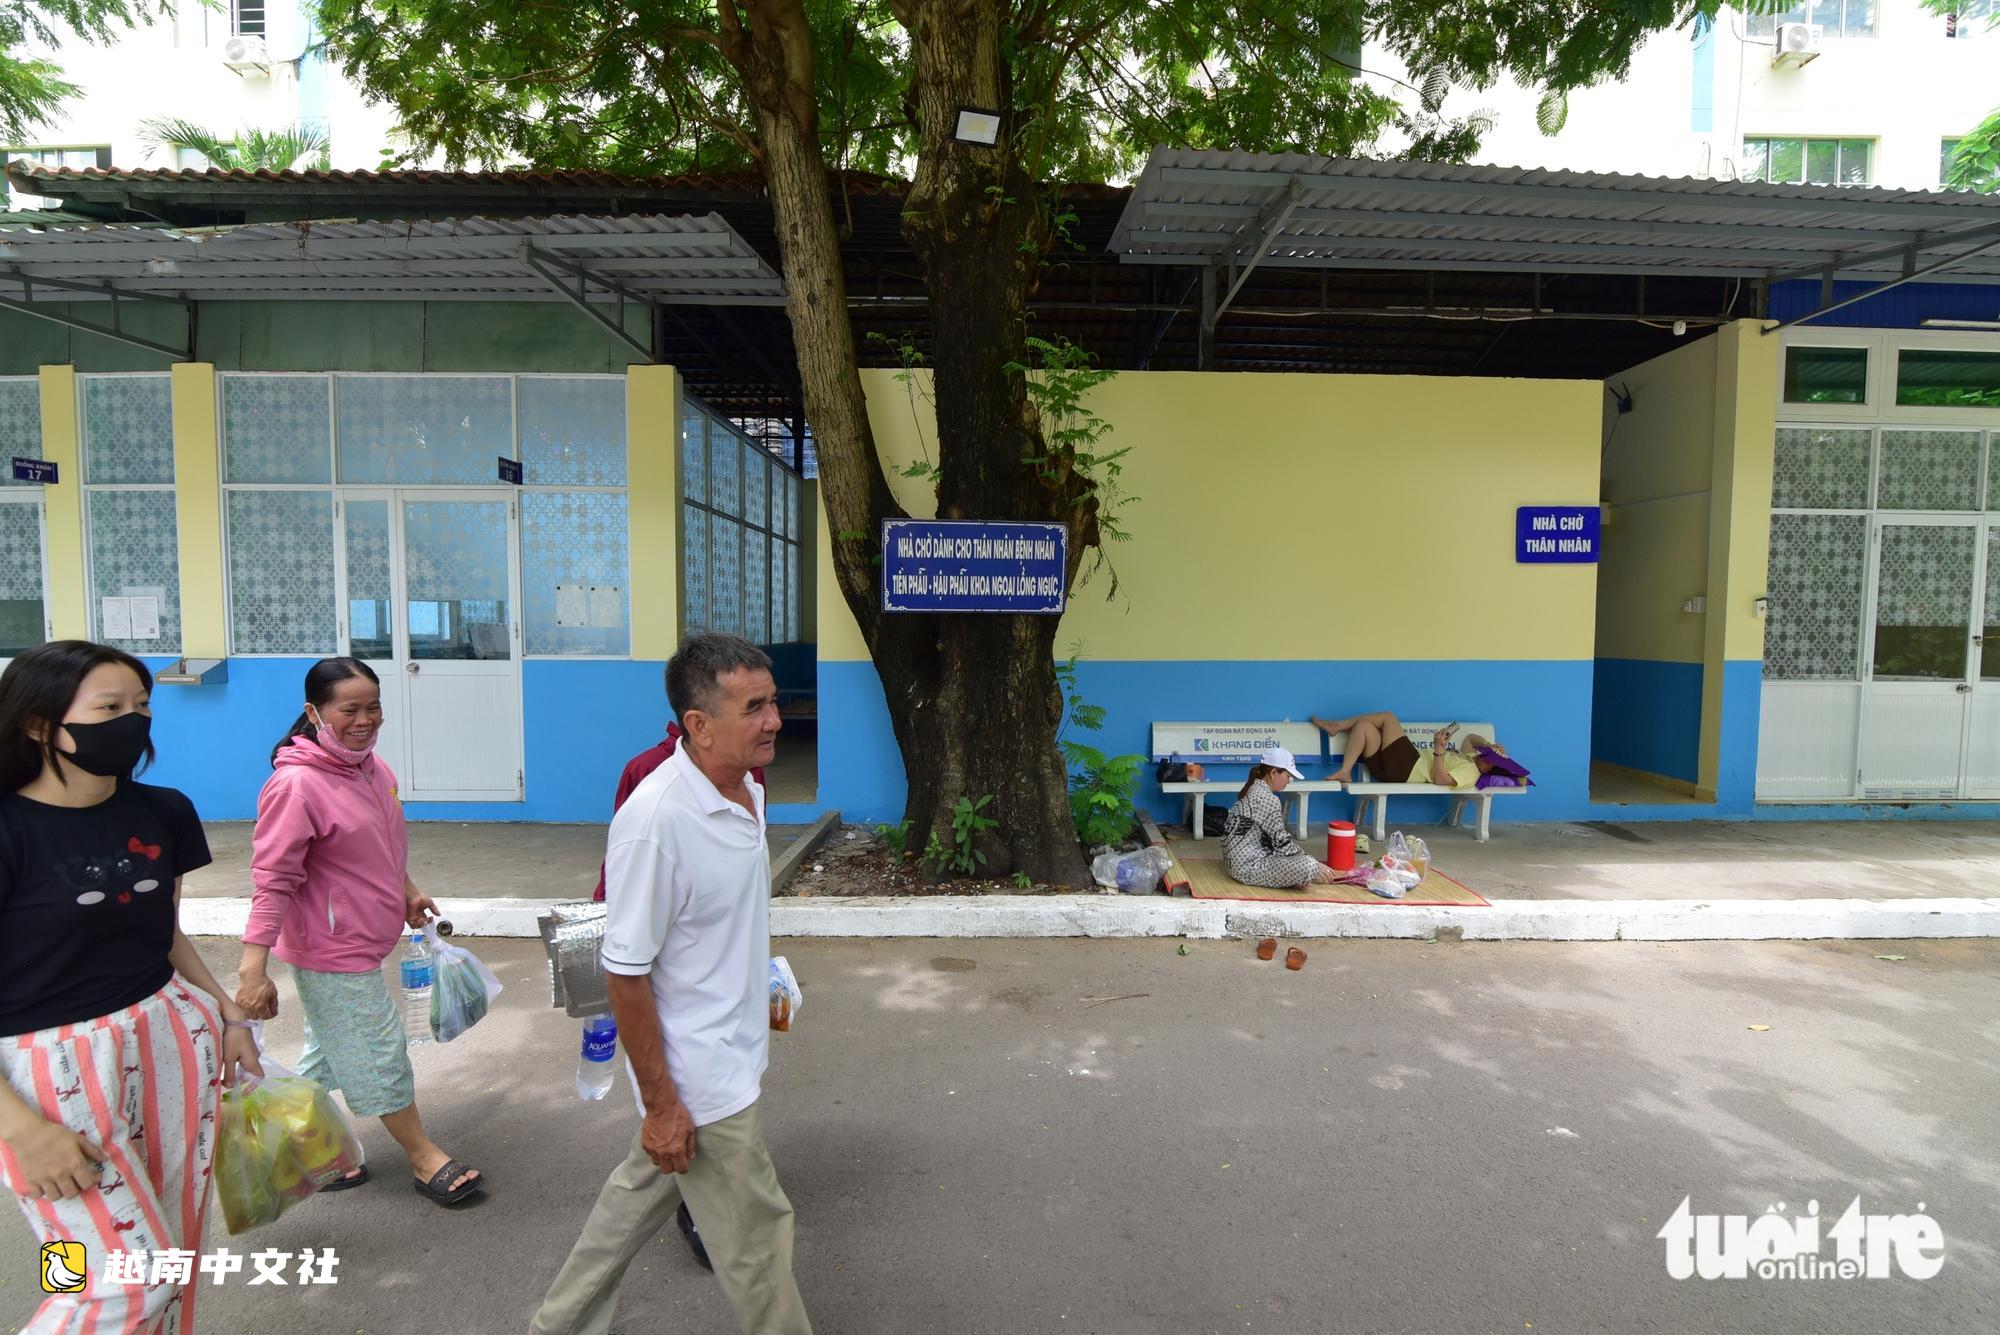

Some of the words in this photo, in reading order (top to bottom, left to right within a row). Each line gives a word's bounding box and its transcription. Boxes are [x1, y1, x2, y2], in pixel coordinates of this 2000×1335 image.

[28, 469, 42, 480] 17
[1533, 513, 1557, 530] NHÀ
[1560, 513, 1584, 530] CHỜ
[898, 532, 914, 558] NHÀ
[915, 532, 932, 559] CHỜ
[933, 532, 954, 559] DÀNH
[955, 538, 972, 559] CHO
[973, 533, 992, 559] THÂN
[993, 533, 1014, 559] NHÂN
[1015, 533, 1034, 566] BỆNH
[1034, 534, 1055, 560] NHÂN
[1525, 536, 1555, 553] THÂN
[1558, 536, 1591, 553] NHÂN
[892, 567, 908, 595] TIỀN
[908, 567, 928, 595] PHẪU
[933, 569, 948, 601] HẬU
[949, 568, 969, 596] PHẪU
[970, 575, 991, 596] KHOA
[991, 575, 1015, 602] NGOẠI
[1037, 573, 1059, 602] NGỰC
[1212, 741, 1252, 749] KHANG
[1253, 736, 1280, 749] ĐIỀN
